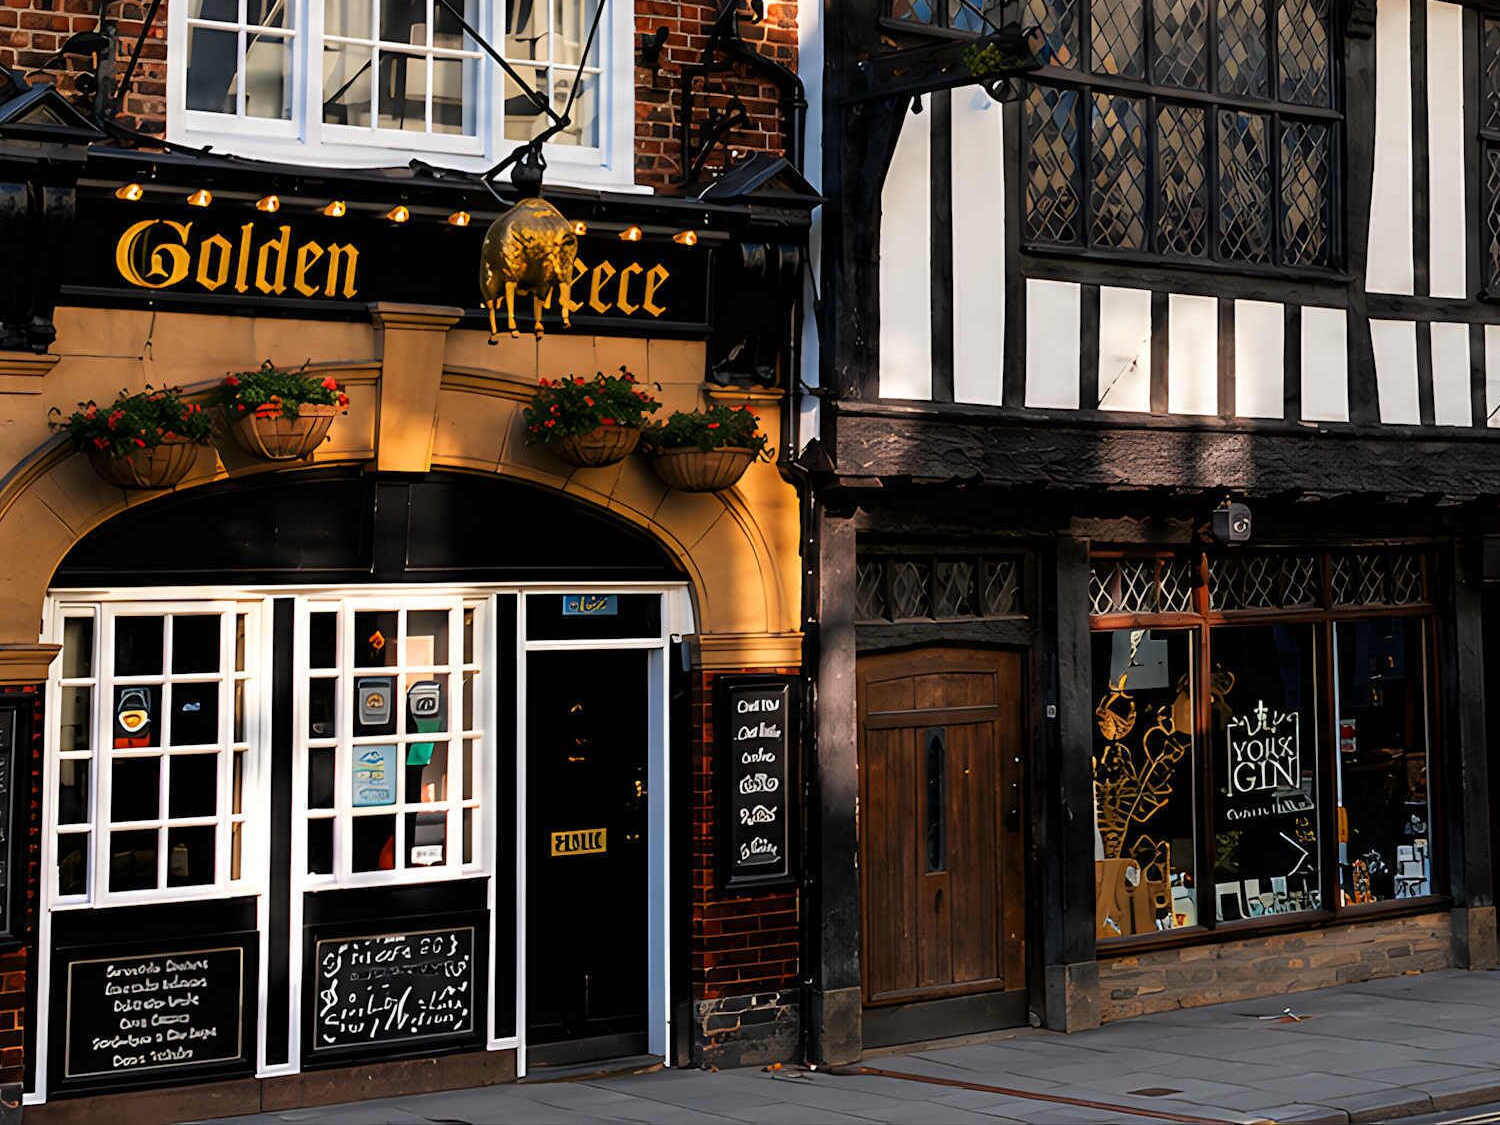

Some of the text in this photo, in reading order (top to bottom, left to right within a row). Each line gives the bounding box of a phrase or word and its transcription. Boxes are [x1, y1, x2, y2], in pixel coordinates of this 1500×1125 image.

[115, 218, 670, 317] Golden eece
[1233, 758, 1297, 792] GIN
